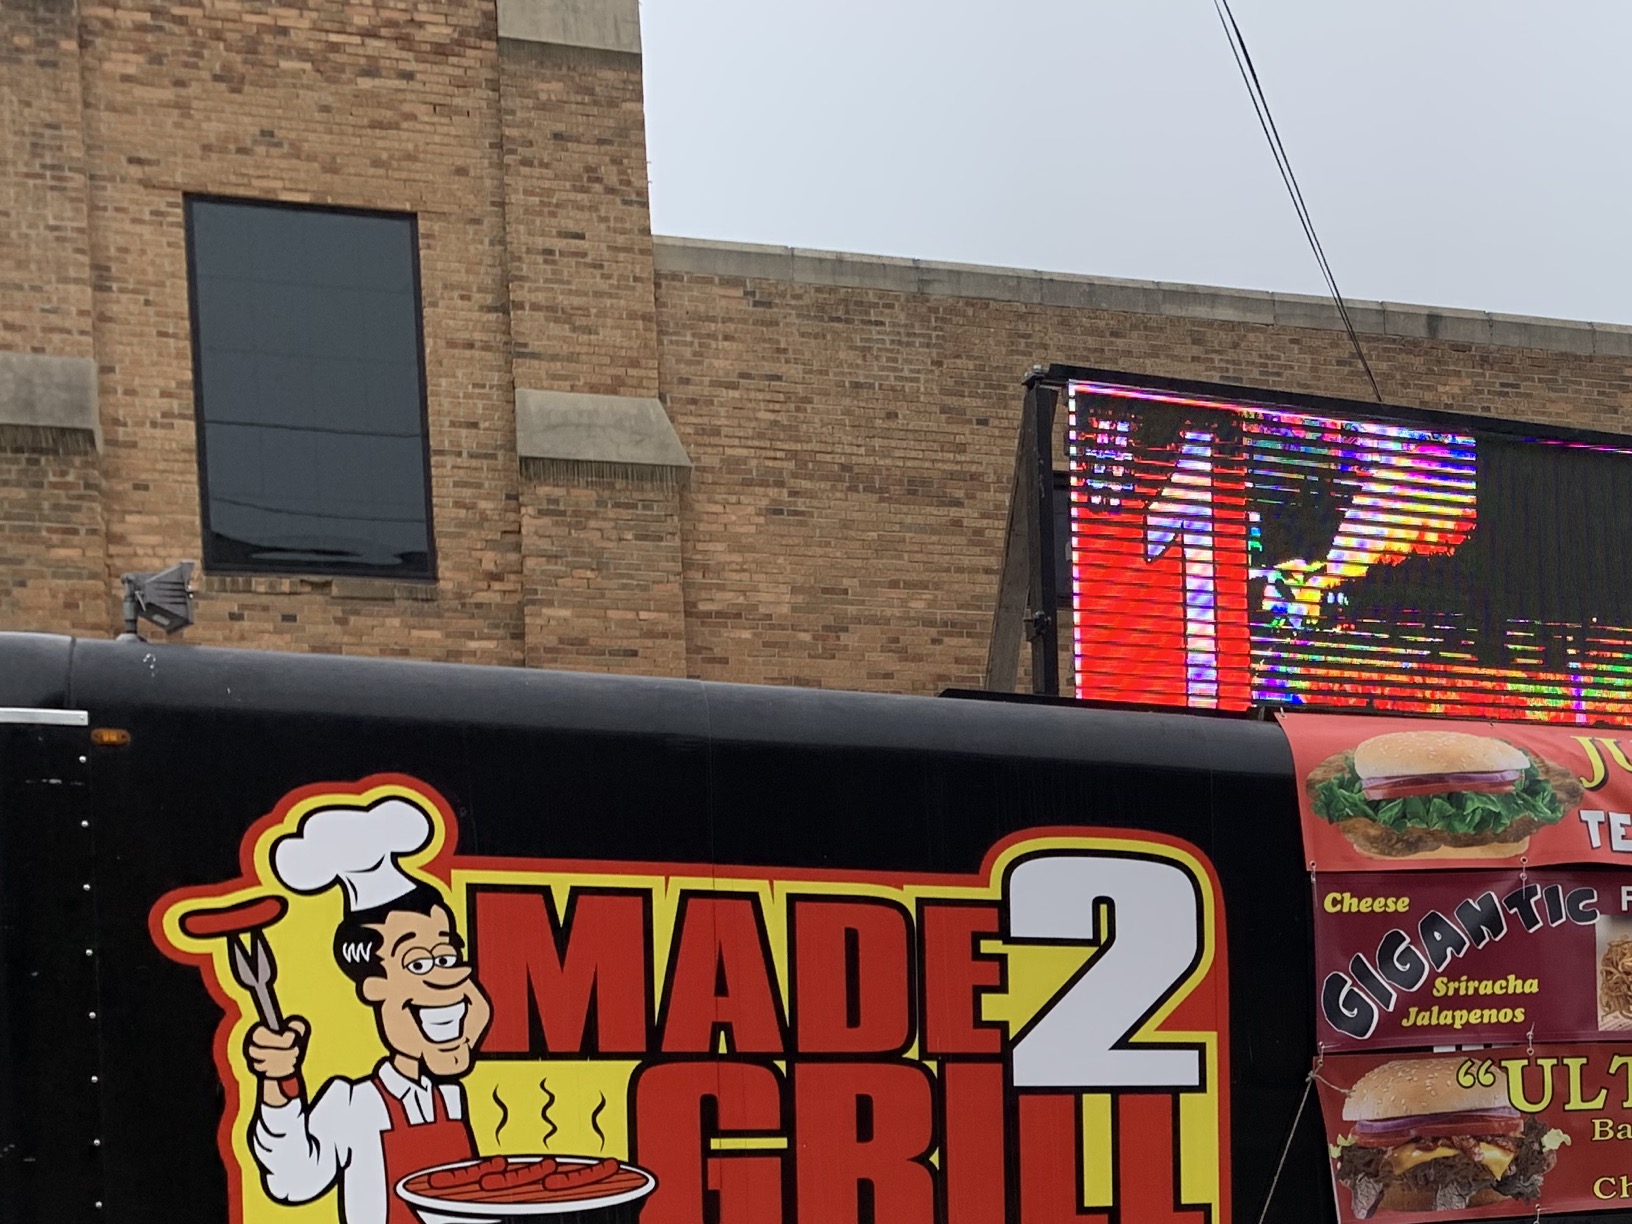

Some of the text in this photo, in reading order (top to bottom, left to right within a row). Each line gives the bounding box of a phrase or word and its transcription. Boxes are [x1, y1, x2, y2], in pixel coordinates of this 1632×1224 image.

[1324, 891, 1410, 914] Cheese
[470, 852, 1206, 1092] MADE 2
[1320, 882, 1600, 1040] GIGANTIC
[1432, 974, 1539, 998] Sriracha
[1401, 1003, 1525, 1028] Jalapenos
